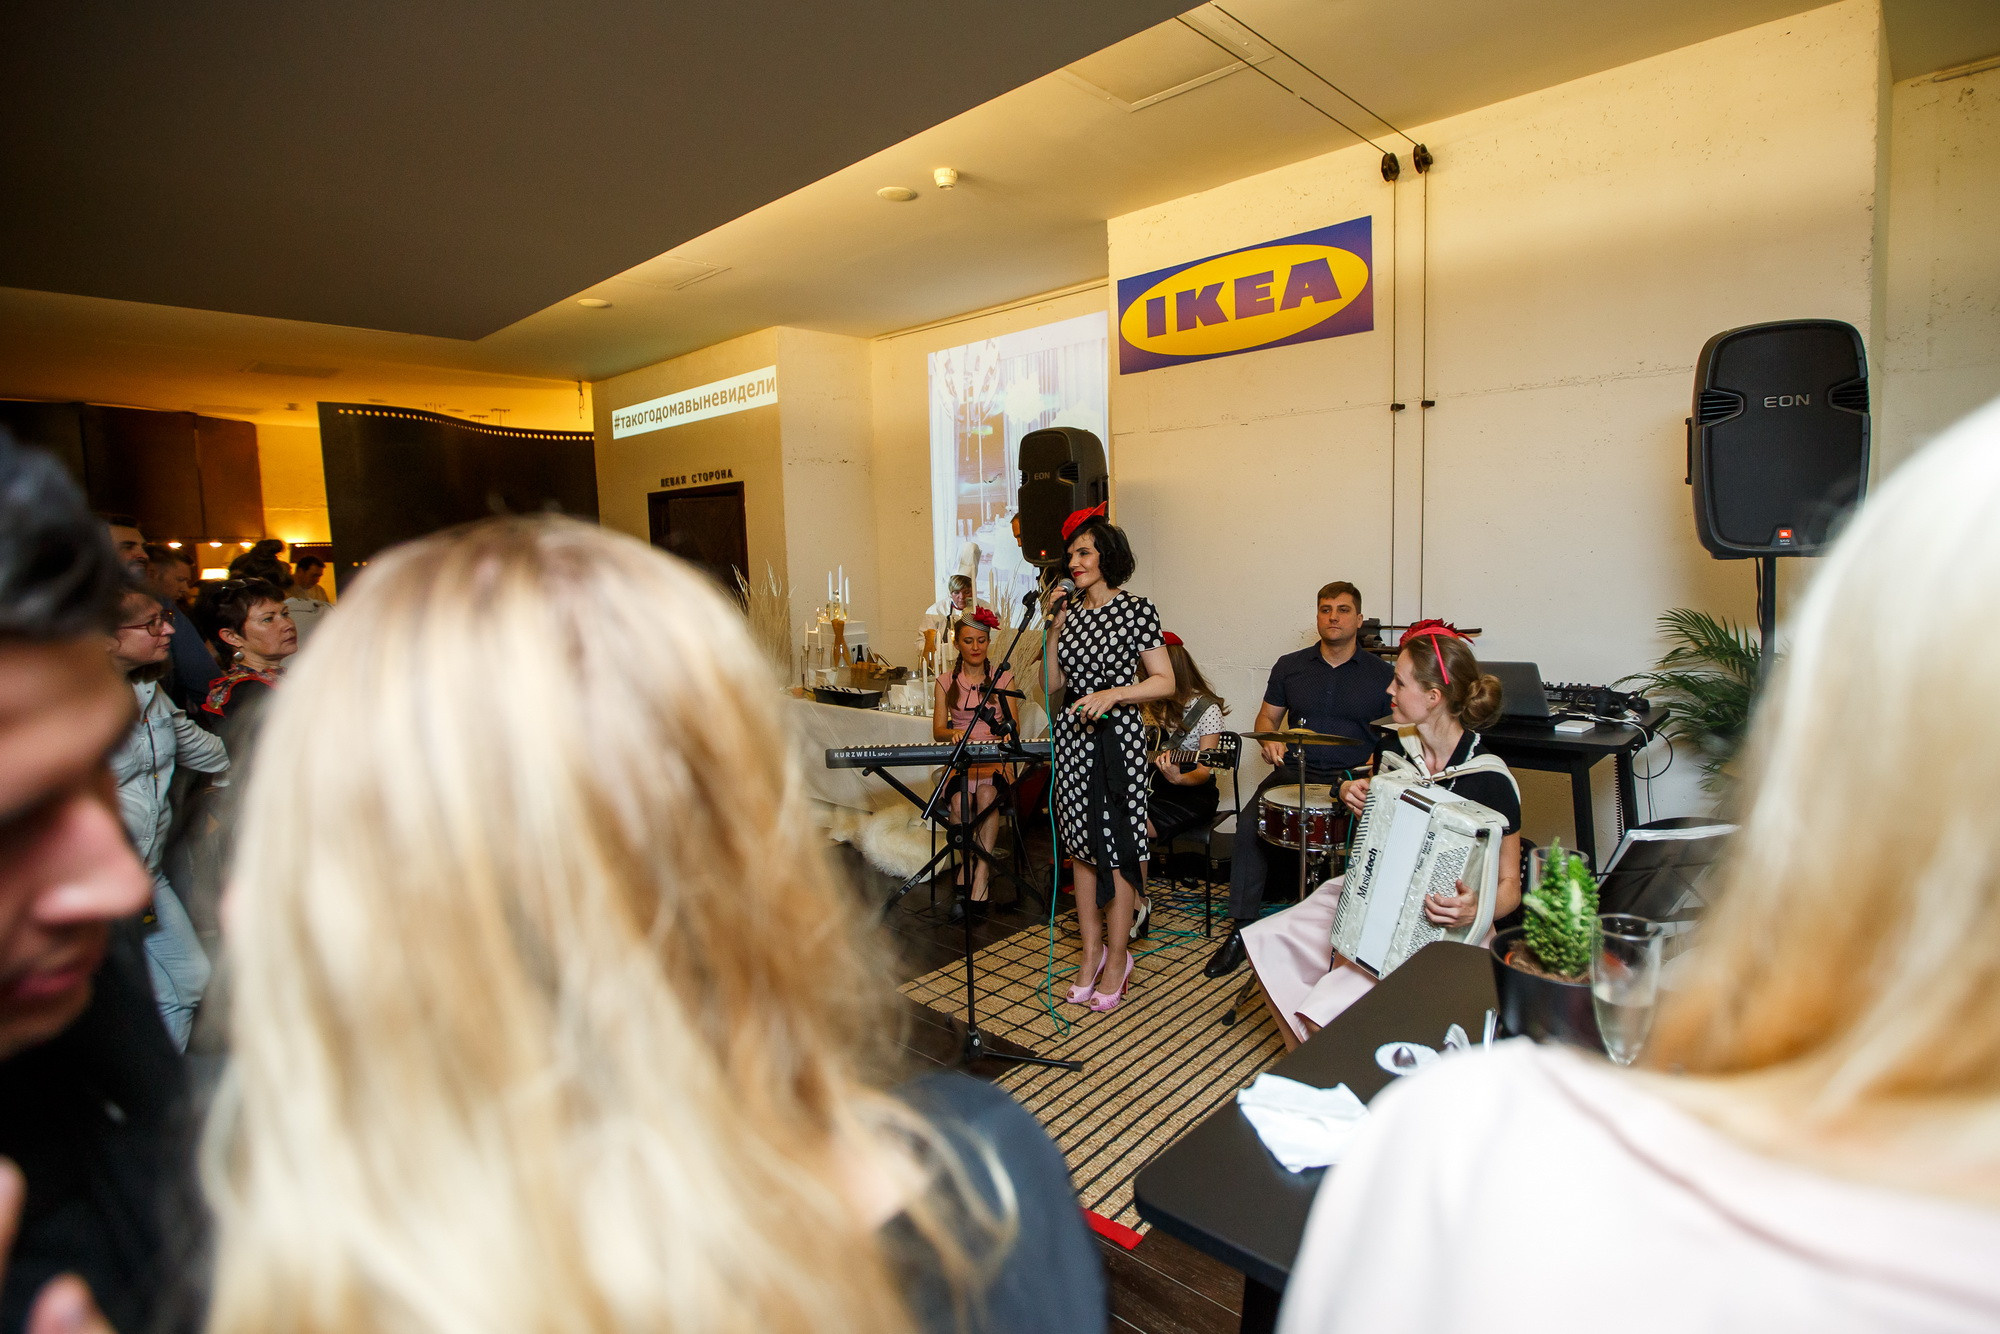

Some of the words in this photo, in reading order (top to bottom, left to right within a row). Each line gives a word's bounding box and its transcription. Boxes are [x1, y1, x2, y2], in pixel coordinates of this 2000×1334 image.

[1146, 257, 1343, 338] IKEA
[614, 377, 775, 430] #такогодомавыневидели
[1763, 394, 1810, 408] EON
[691, 469, 734, 484] СТОРОНА
[1034, 472, 1050, 480] EON
[1427, 831, 1436, 841] 50
